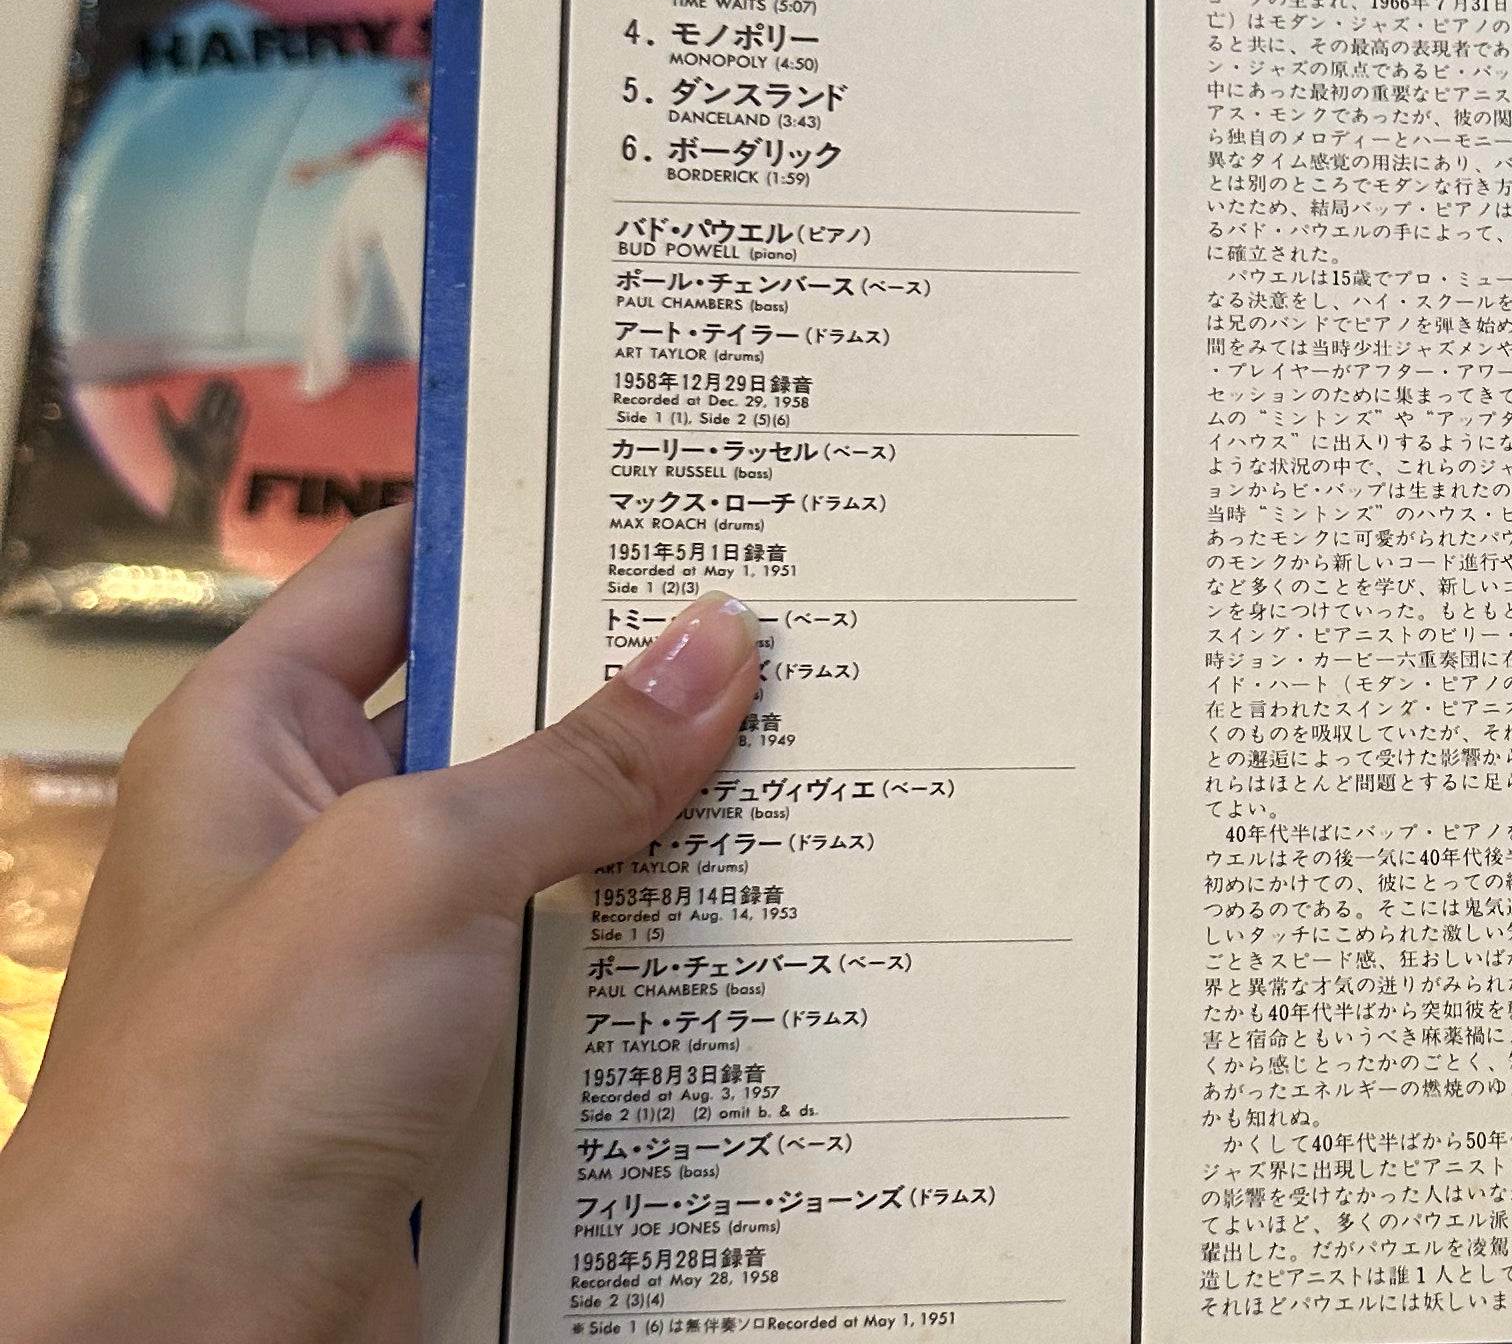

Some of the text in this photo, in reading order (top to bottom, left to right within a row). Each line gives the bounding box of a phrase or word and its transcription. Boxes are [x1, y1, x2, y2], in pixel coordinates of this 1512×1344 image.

[670, 20, 820, 53] モノポリー
[669, 52, 819, 74] MONOPOLY (4:50)
[669, 76, 849, 113] ダンスランド
[667, 109, 822, 131] DANCELAND (3:43)
[667, 136, 842, 170] ボーダリック
[666, 167, 810, 188] BORDERICK (1:59)
[617, 241, 797, 263] BUD POWELL (piano)
[613, 372, 814, 395] 1958年12月29日録音
[594, 885, 784, 908] 1953年8月14日録音
[1202, 1108, 1323, 1129] かも知れぬ。
[571, 1246, 768, 1272] 1958年5月28日録音
